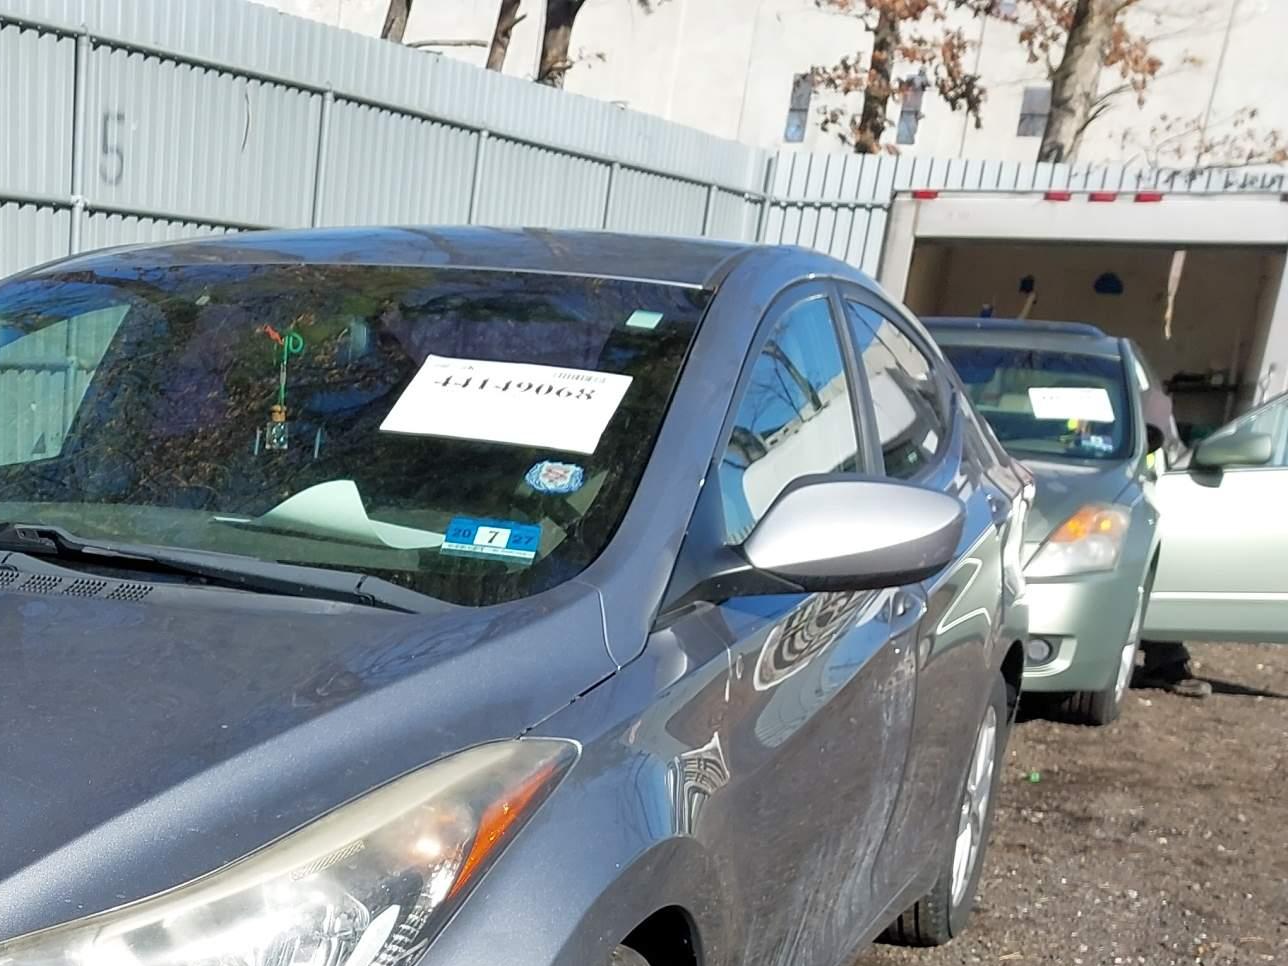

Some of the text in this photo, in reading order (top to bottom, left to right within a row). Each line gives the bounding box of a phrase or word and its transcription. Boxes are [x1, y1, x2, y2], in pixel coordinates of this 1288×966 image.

[99, 111, 125, 187] 5
[434, 375, 596, 401] 44149068
[452, 527, 535, 546] 20 7 27
